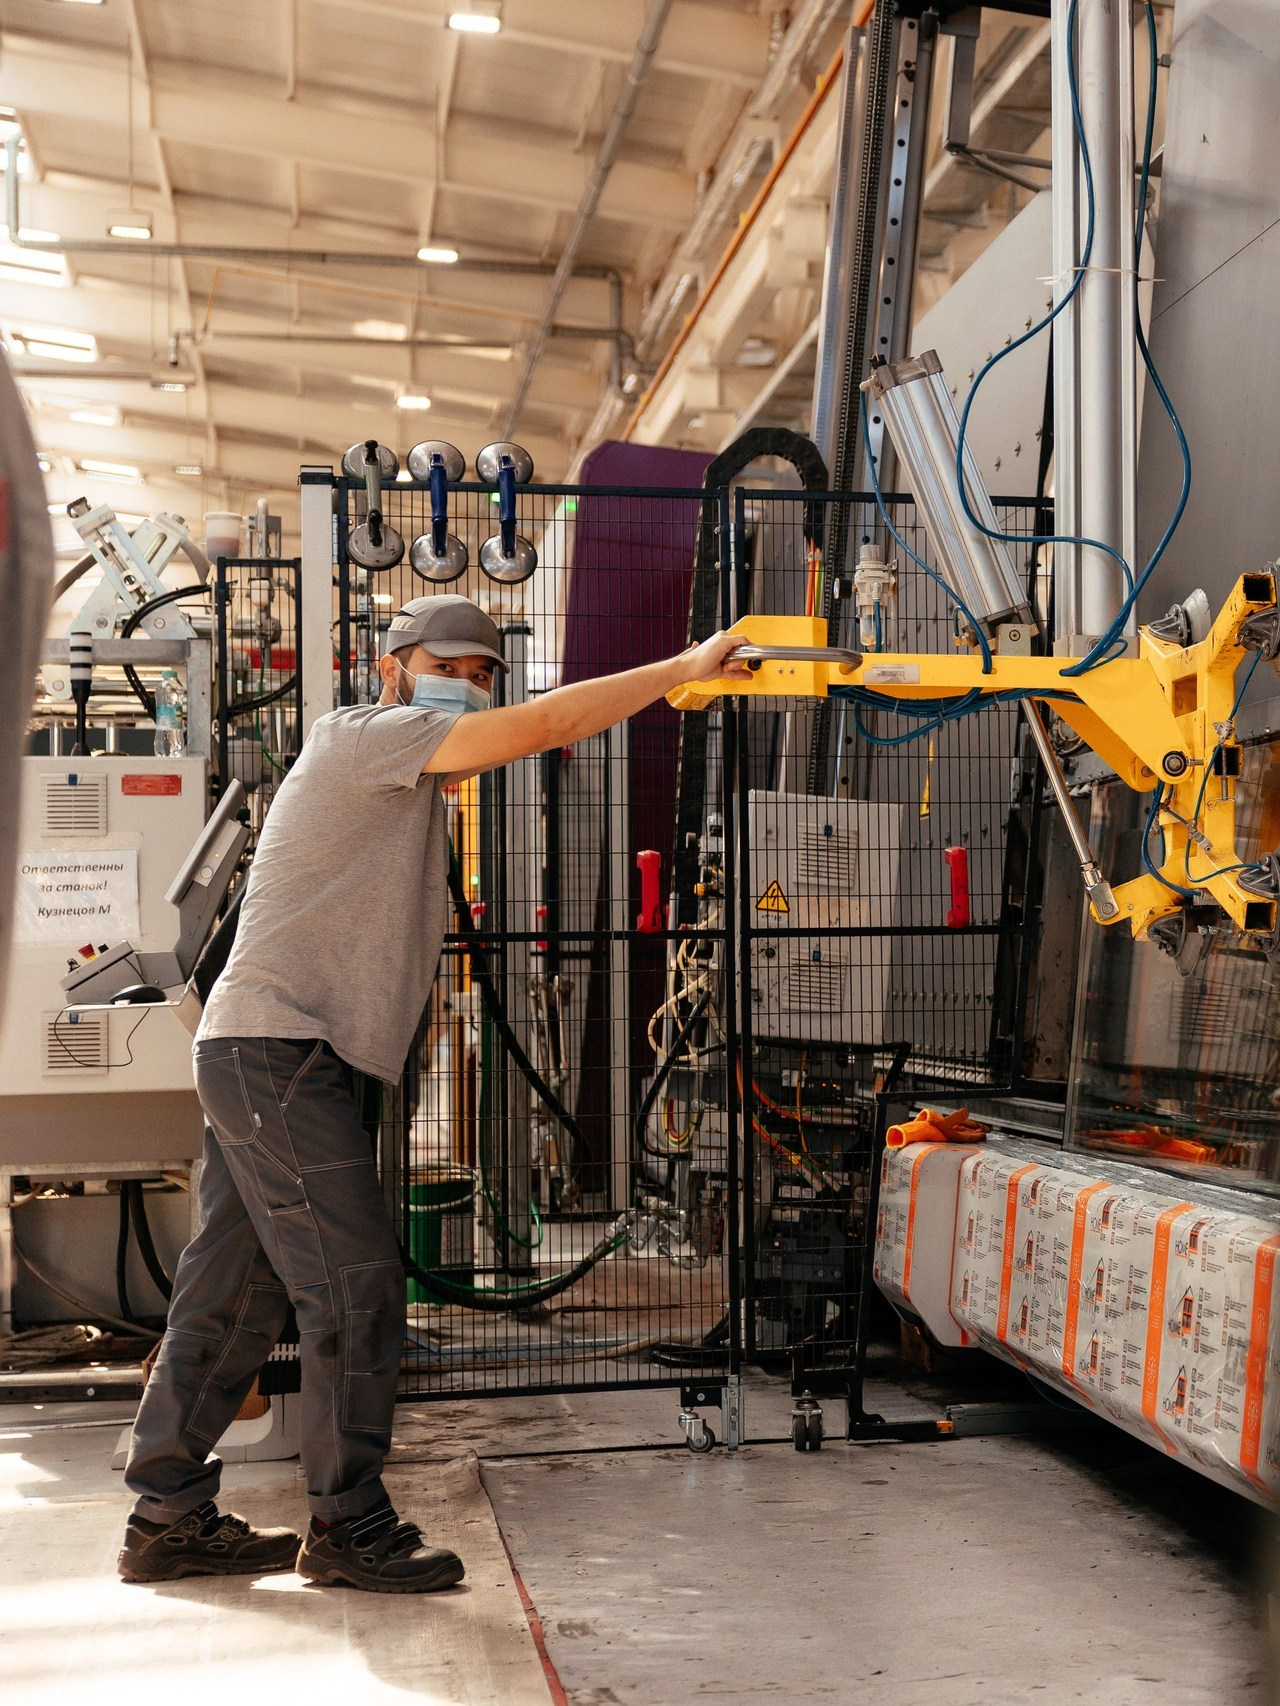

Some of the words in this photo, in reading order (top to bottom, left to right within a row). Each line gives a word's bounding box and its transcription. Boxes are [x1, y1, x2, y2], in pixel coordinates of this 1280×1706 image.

[21, 863, 124, 875] Ответственны
[38, 884, 53, 893] за
[56, 880, 108, 893] станок!
[37, 906, 96, 919] Кузнецов
[98, 904, 111, 915] М
[1174, 1240, 1189, 1256] HOME
